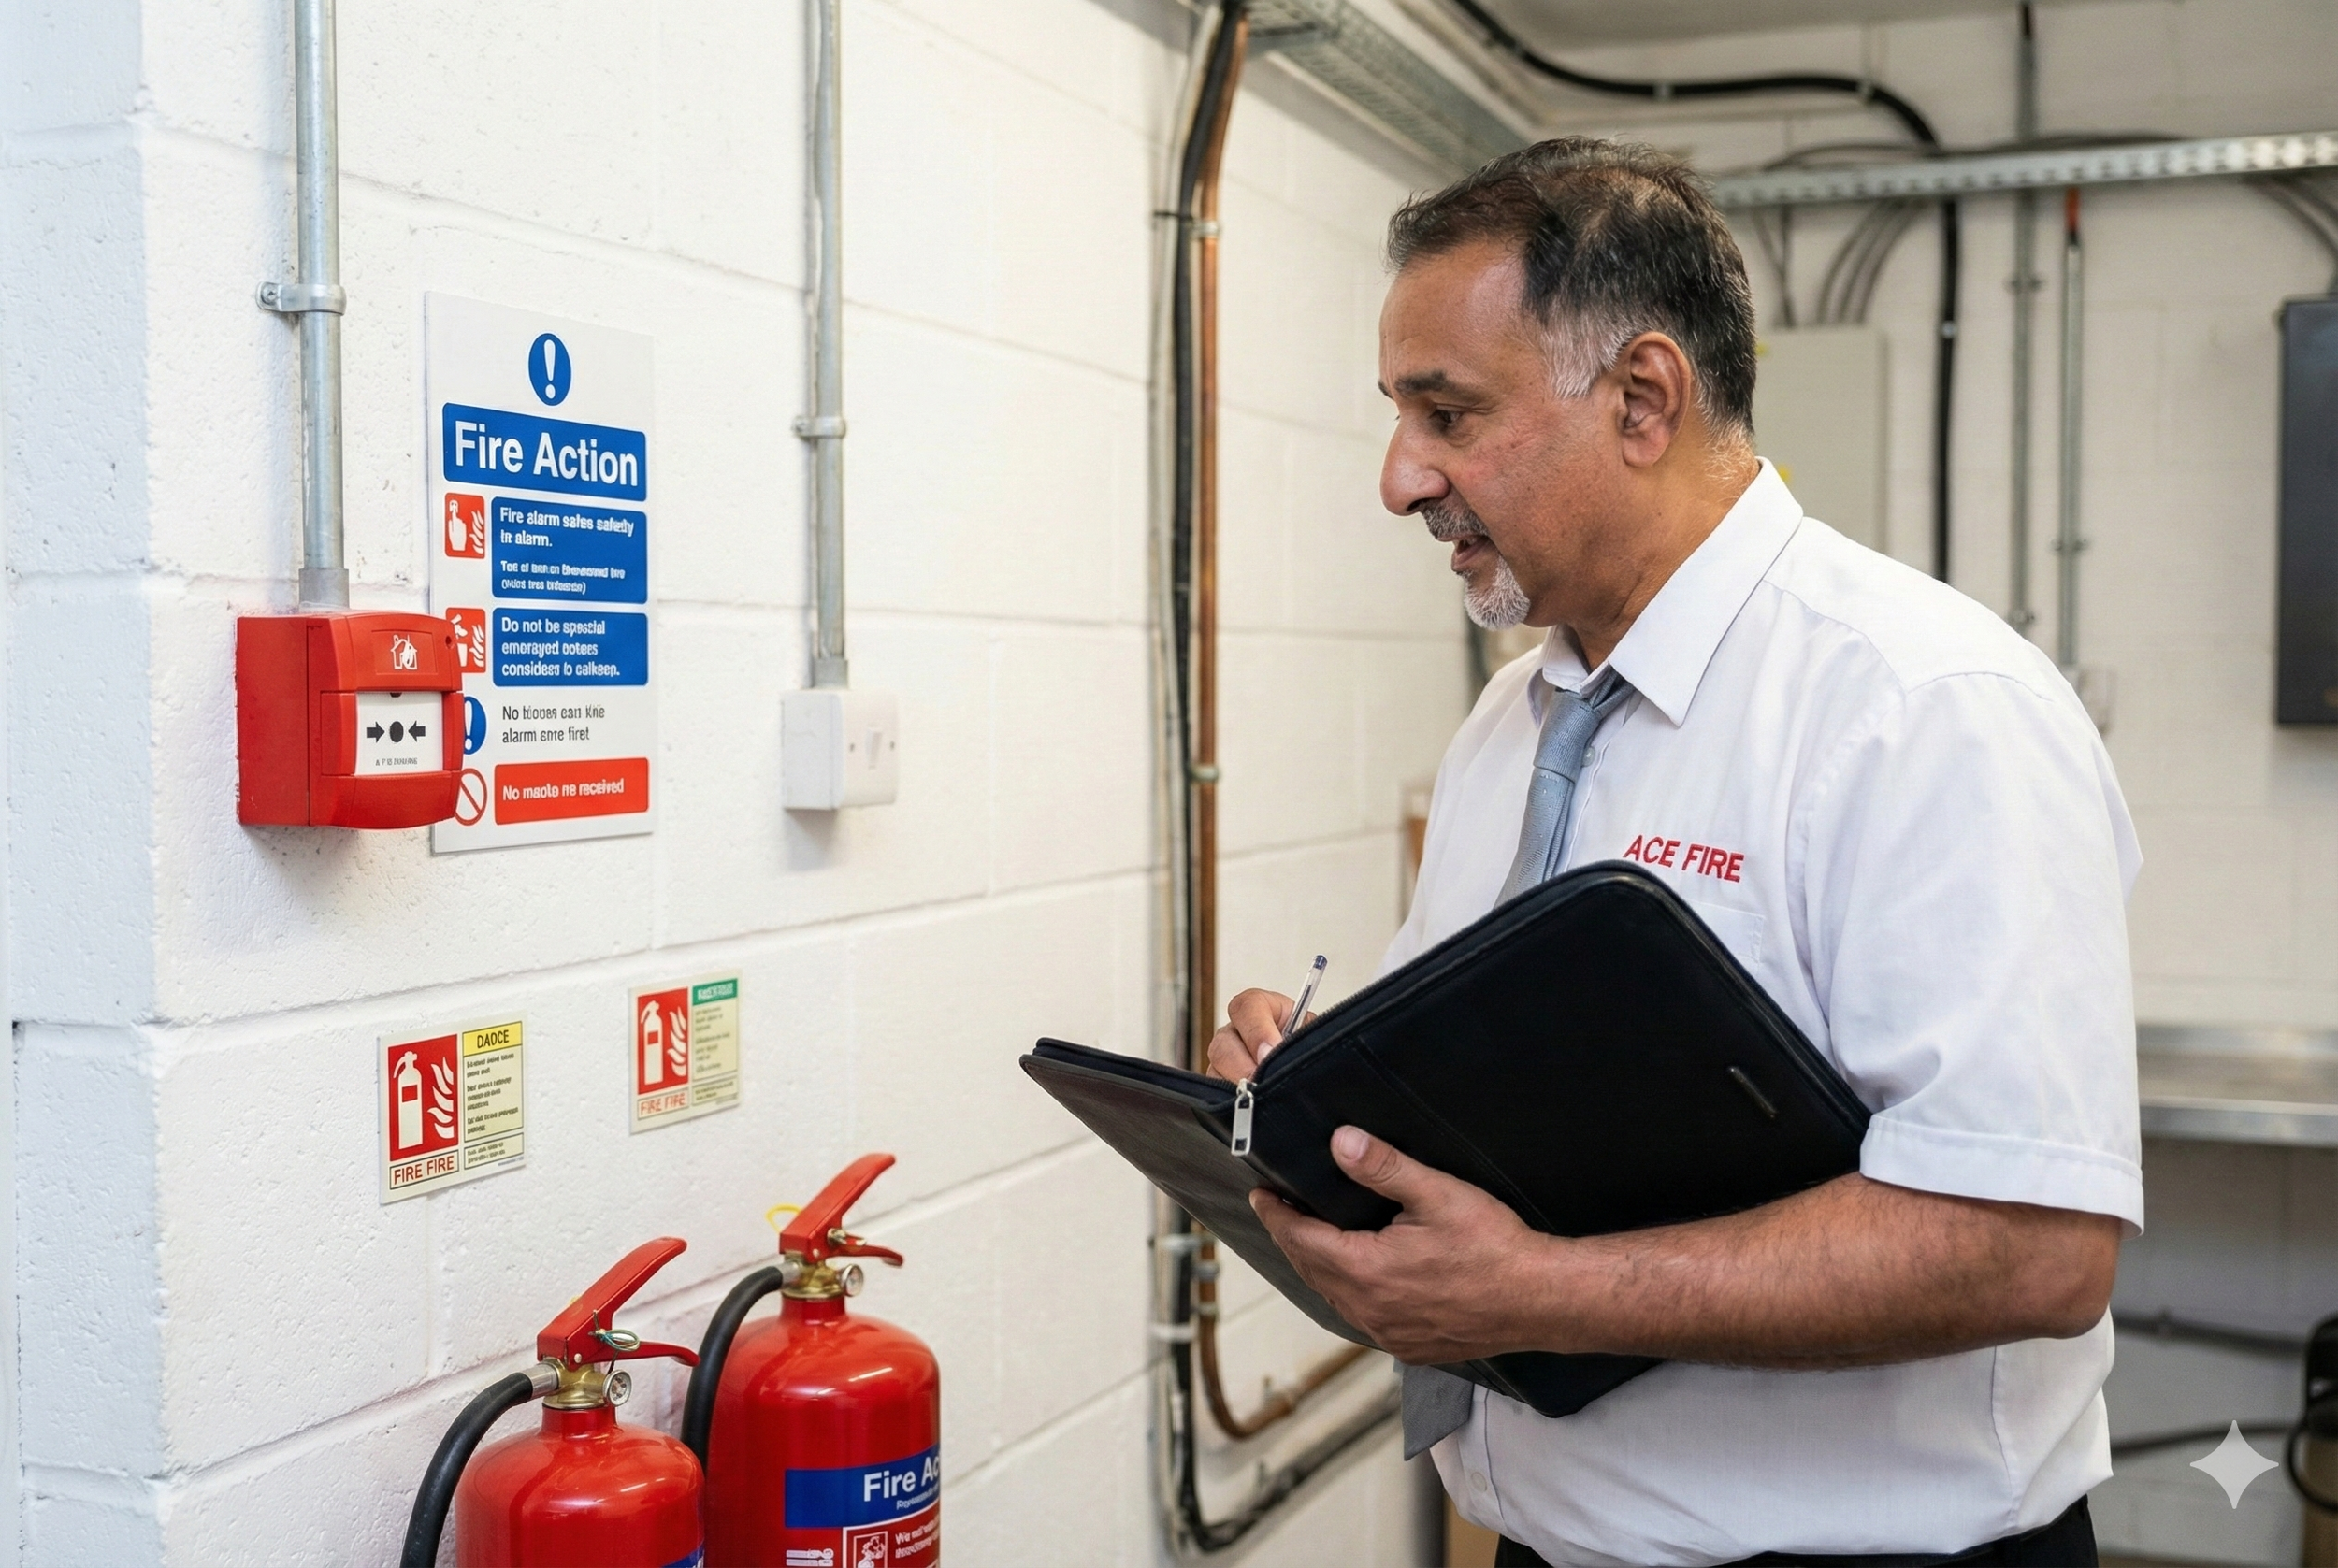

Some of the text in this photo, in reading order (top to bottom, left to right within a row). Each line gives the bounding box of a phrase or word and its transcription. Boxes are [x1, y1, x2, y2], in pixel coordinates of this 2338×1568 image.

[455, 420, 638, 487] Fire Action
[500, 507, 524, 524] Fire
[527, 510, 560, 527] alarm
[515, 530, 553, 547] alarm.
[501, 617, 519, 633] Do
[523, 619, 542, 633] not
[545, 618, 560, 634] be
[502, 706, 519, 720] No
[502, 728, 537, 743] alarm
[502, 785, 520, 801] No
[1623, 834, 1745, 883] ACE FIRE
[394, 1161, 423, 1186] FIRE
[426, 1155, 455, 1176] FIRE
[864, 1470, 916, 1503] Fire
